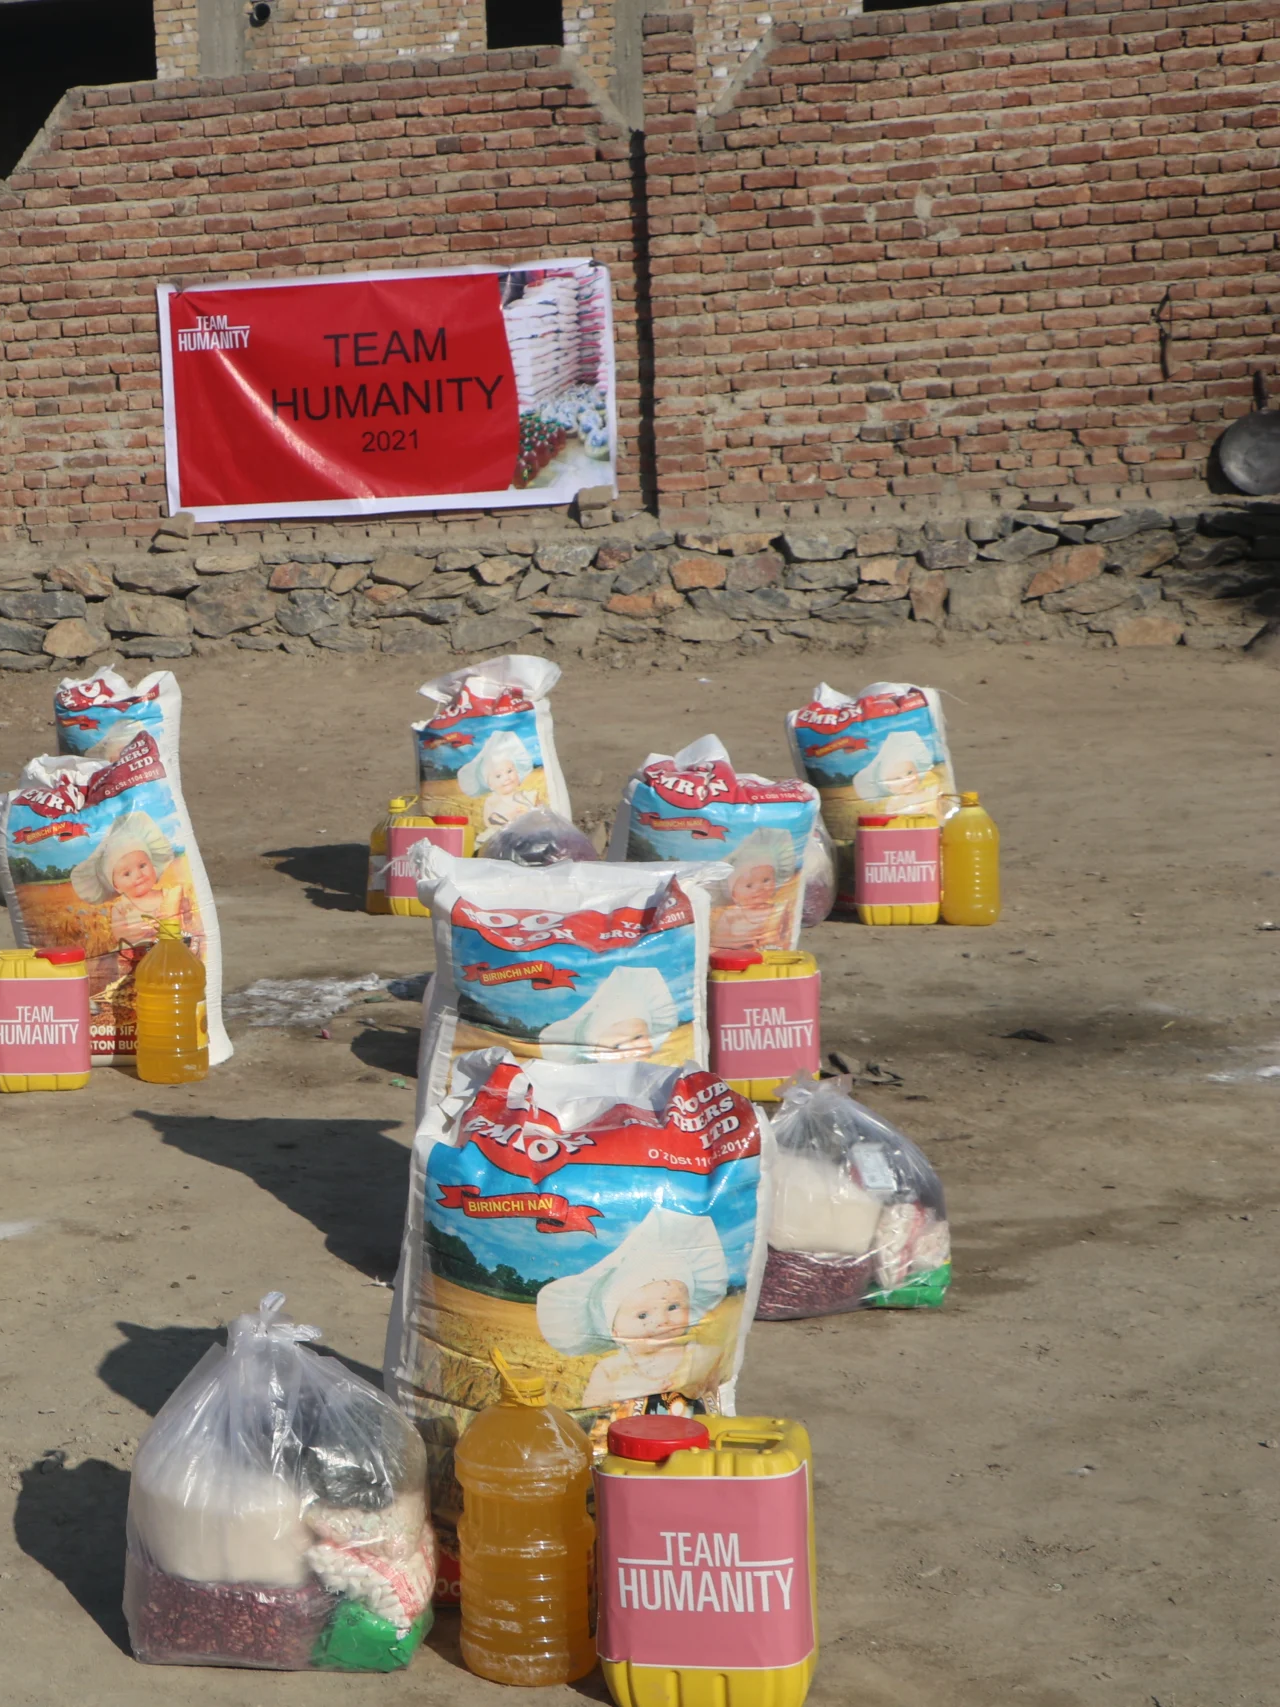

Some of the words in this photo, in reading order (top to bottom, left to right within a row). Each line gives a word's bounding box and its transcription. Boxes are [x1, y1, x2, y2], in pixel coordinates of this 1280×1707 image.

[196, 315, 228, 331] TEAM
[178, 326, 250, 352] HUMANITY
[324, 328, 447, 368] TEAM
[271, 375, 504, 421] HUMANITY
[362, 430, 419, 453] 2021
[128, 755, 154, 771] LTD
[884, 850, 915, 864] TEAM
[865, 865, 937, 883] HUMANITY
[482, 967, 522, 983] BIRINCHI
[523, 964, 544, 977] NAV
[16, 1006, 54, 1022] TEAM
[743, 1007, 786, 1026] TEAM
[720, 1024, 813, 1051] HUMANITY
[699, 1116, 740, 1150] LTD
[468, 1197, 525, 1214] BIRINCHI
[527, 1197, 554, 1212] NAV
[660, 1531, 740, 1567] TEAM
[618, 1567, 795, 1613] HUMANITY
